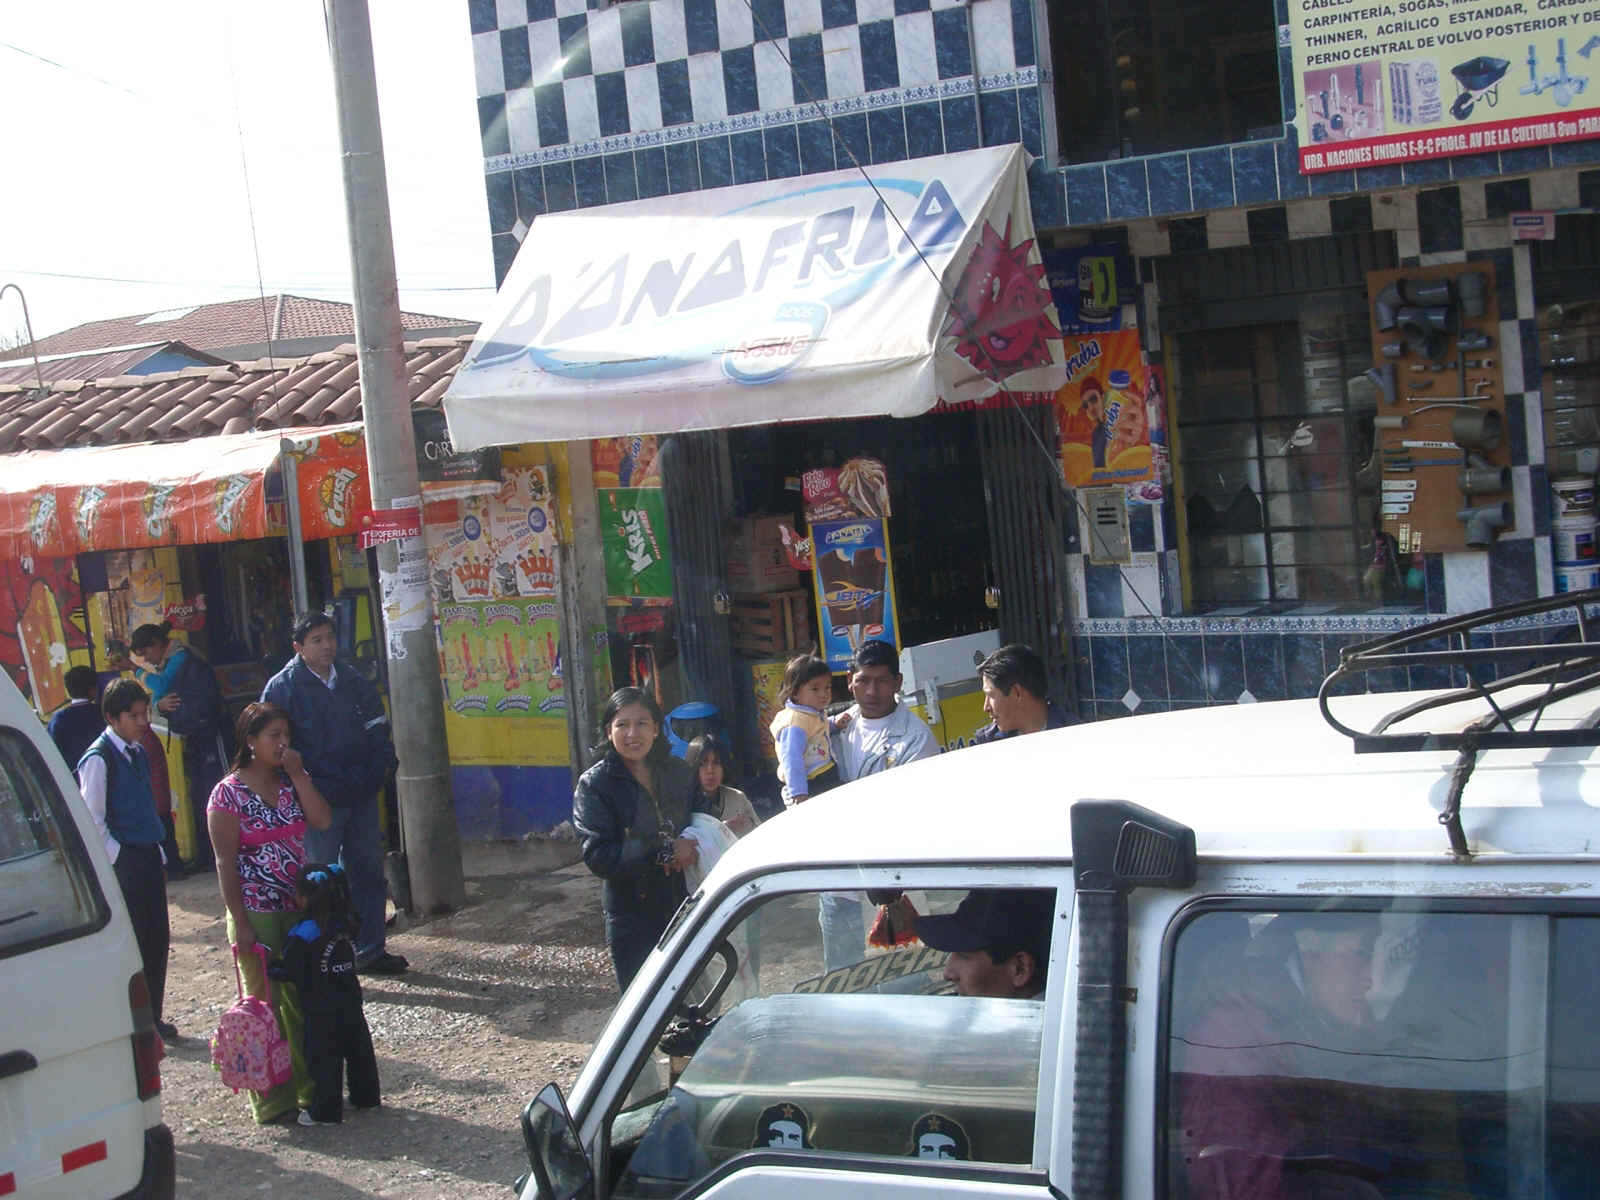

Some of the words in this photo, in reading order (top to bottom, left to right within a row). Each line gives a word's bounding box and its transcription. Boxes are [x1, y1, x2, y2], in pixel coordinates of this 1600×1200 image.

[1305, 29, 1367, 47] THINNER,
[1449, 3, 1527, 24] ESTANDAR,
[1306, 49, 1350, 66] PERNO
[1353, 40, 1415, 58] CENTRAL
[1417, 36, 1434, 49] DE
[1437, 29, 1483, 46] VOLVO
[1485, 15, 1568, 38] POSTERIOR
[1570, 13, 1580, 25] Y
[1326, 145, 1372, 167] NACIONES
[1372, 141, 1408, 161] UNIDAS
[1484, 129, 1497, 146] DE
[1498, 127, 1511, 144] LA
[1511, 123, 1556, 143] CULTURA
